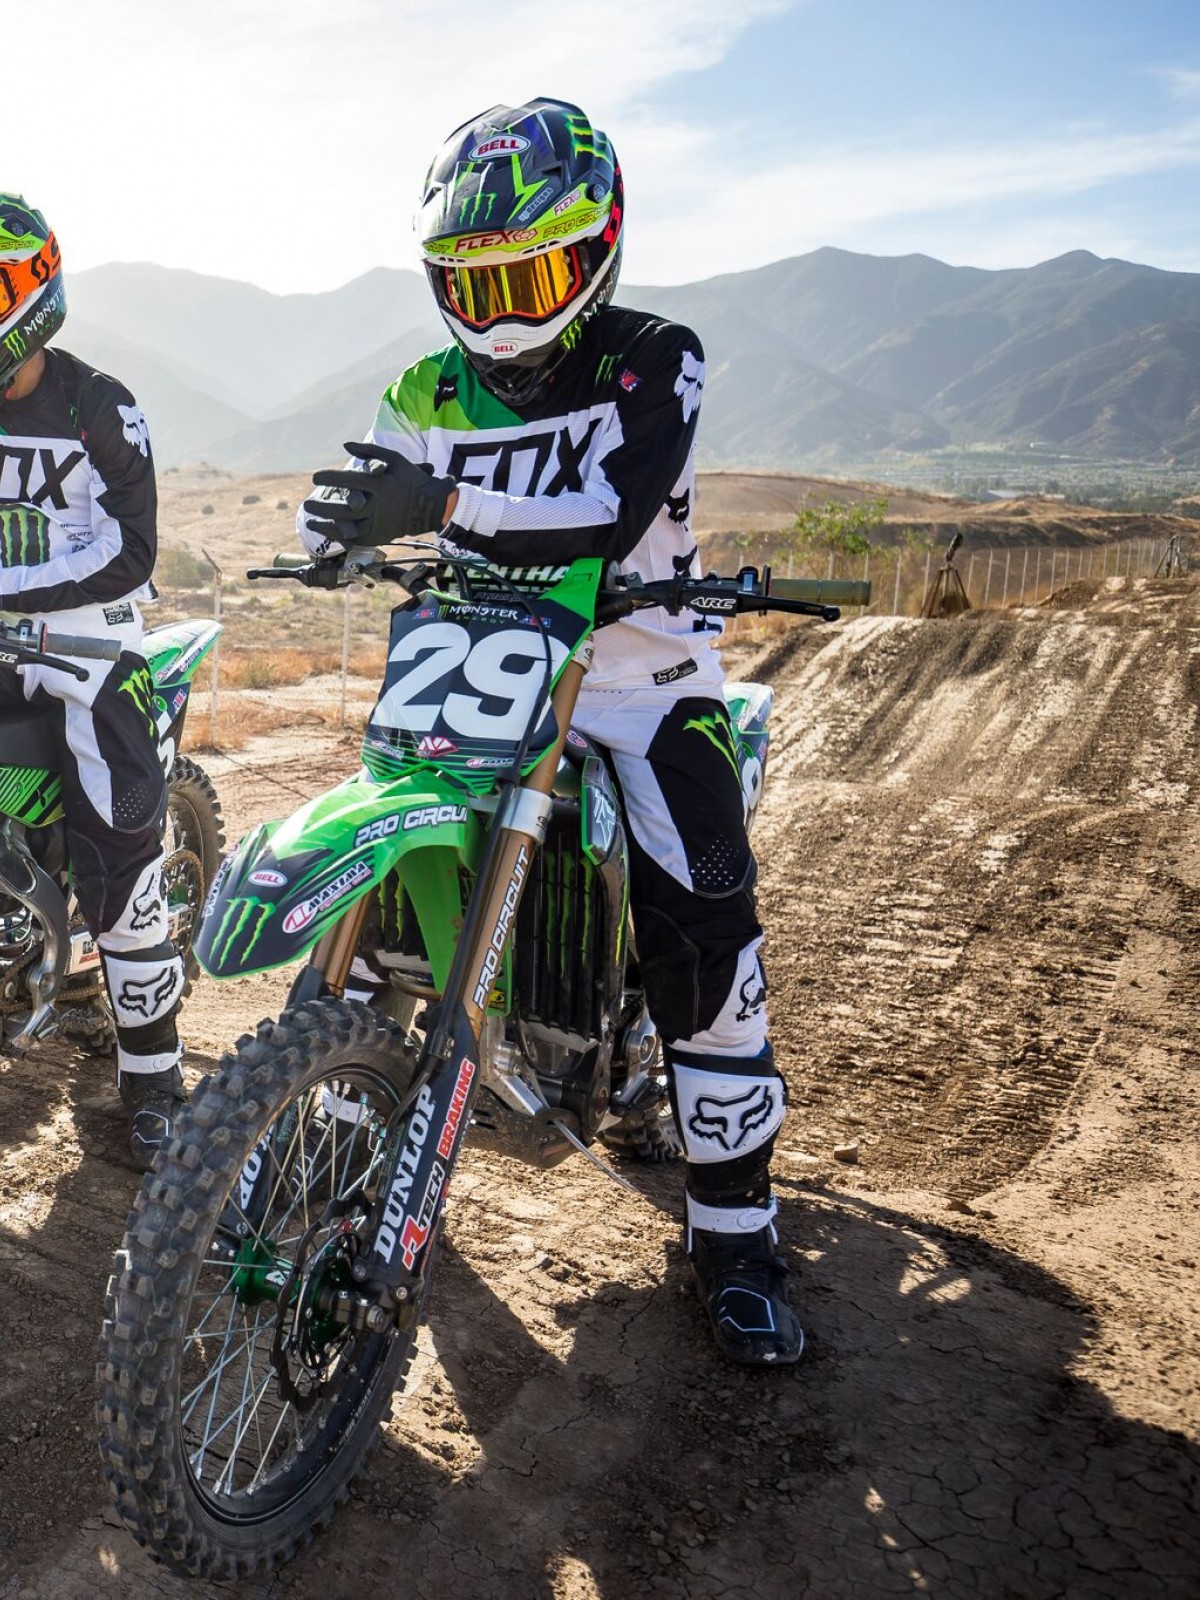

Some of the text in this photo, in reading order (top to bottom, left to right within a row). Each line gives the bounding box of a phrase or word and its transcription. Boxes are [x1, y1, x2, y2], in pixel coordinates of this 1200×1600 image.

[477, 139, 520, 155] BELL
[543, 217, 576, 238] PRO
[454, 231, 510, 254] FLEX
[493, 345, 514, 353] BELL
[446, 417, 603, 498] FOX
[443, 563, 571, 582] RENTHA
[449, 604, 518, 620] MONSTER
[690, 596, 737, 610] ARC
[370, 622, 570, 741] 29
[354, 804, 468, 849] PRO CIRCUI
[254, 873, 281, 884] BELL
[473, 845, 531, 1010] PRO CIRCUIT
[436, 1057, 476, 1160] BRAKING
[373, 1084, 437, 1264] DUNLOP
